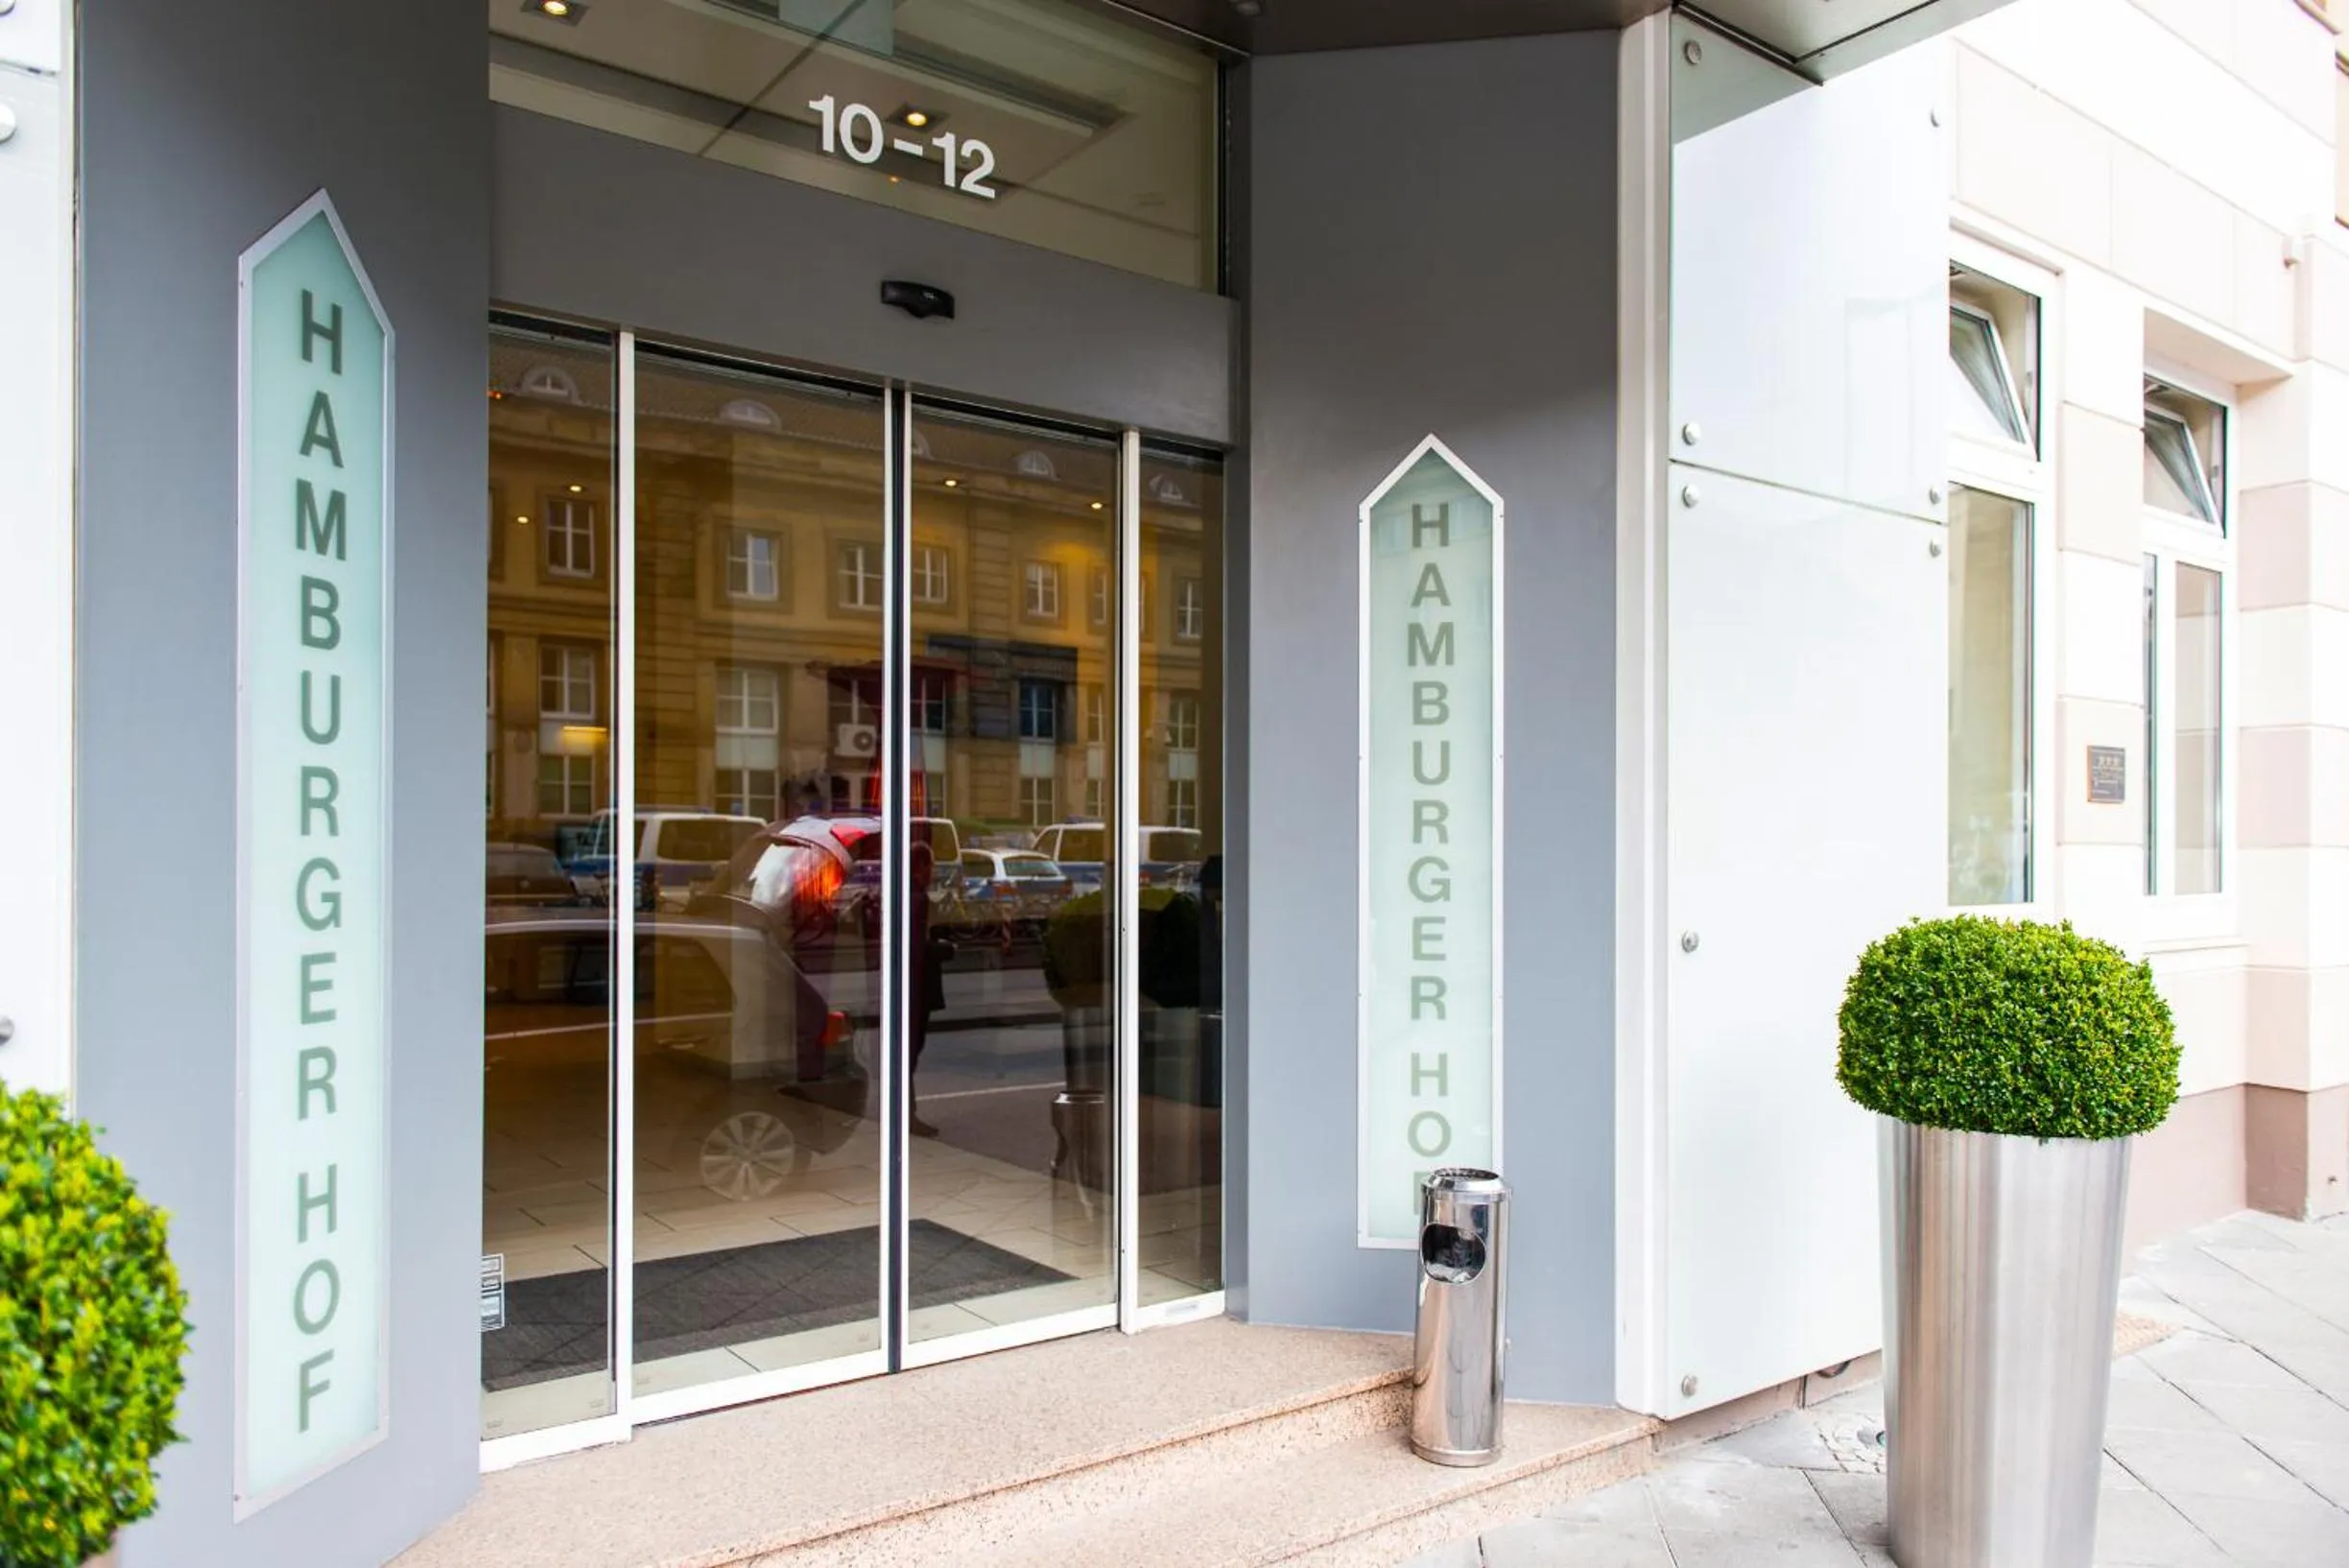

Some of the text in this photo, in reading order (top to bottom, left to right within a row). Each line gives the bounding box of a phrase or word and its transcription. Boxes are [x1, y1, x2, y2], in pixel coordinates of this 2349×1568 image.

[809, 95, 996, 199] 10-12
[293, 289, 347, 1432] HAMBURGER HOF
[1407, 503, 1455, 1020] HAMBURGER
